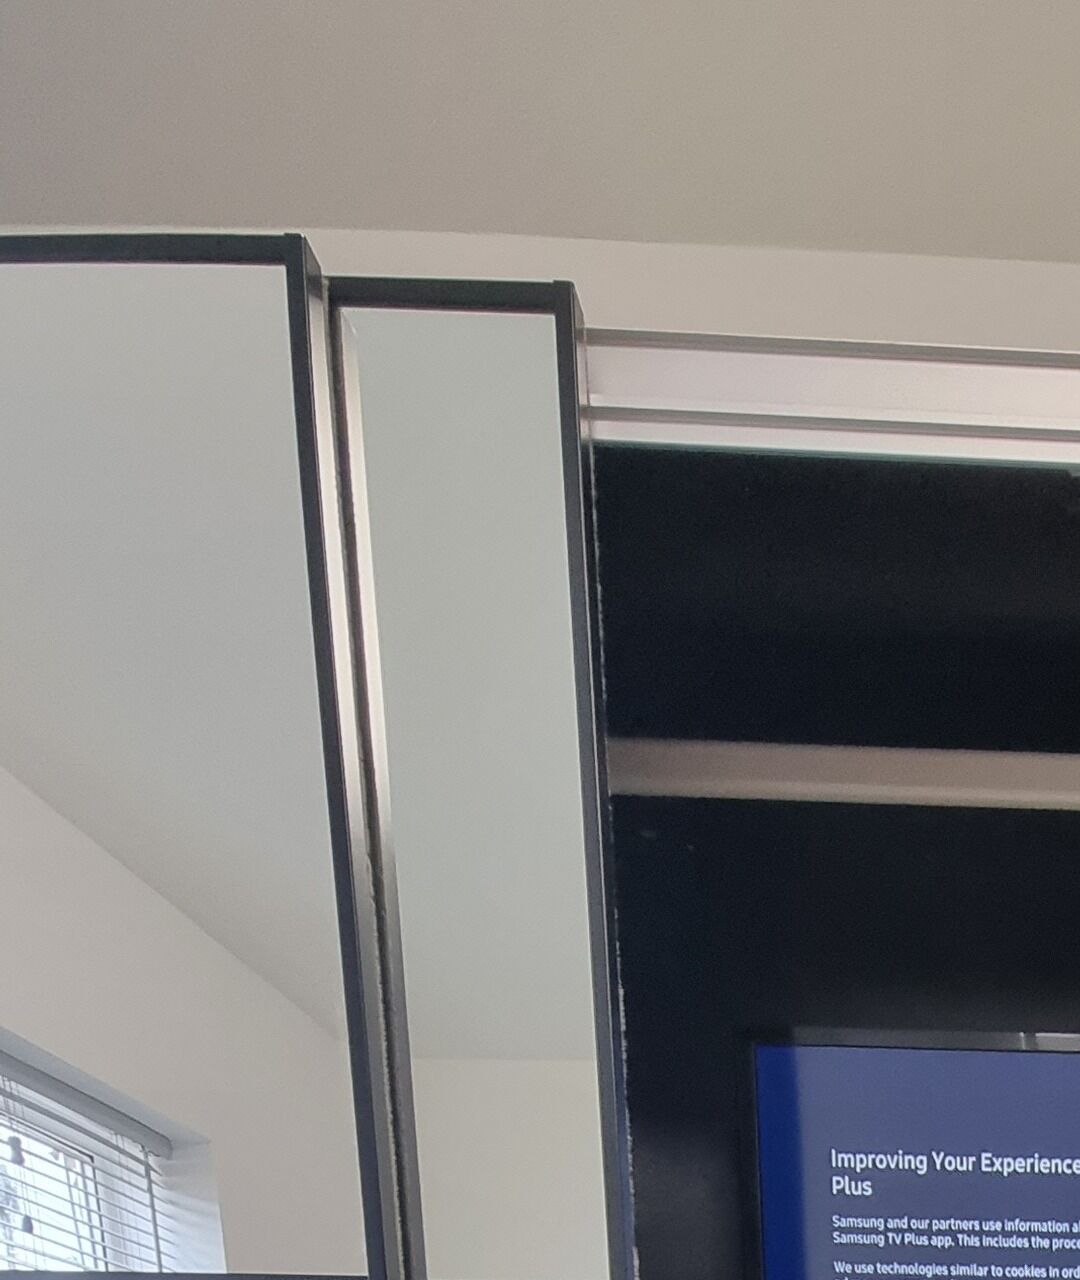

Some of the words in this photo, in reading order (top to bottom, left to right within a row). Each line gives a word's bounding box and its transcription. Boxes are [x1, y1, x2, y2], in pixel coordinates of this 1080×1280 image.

[829, 1148, 927, 1175] Improving
[932, 1150, 976, 1171] Your
[830, 1174, 872, 1195] Plus
[831, 1214, 884, 1233] Samsung
[886, 1215, 907, 1230] and
[909, 1218, 929, 1230] our
[932, 1217, 979, 1235] partners
[981, 1220, 1002, 1232] use
[1004, 1217, 1069, 1233] information
[832, 1230, 884, 1249] Samsung
[887, 1231, 901, 1245] TV
[903, 1231, 928, 1246] Plus
[930, 1235, 954, 1250] app.
[956, 1233, 980, 1247] This
[982, 1233, 1029, 1248] includes
[1030, 1234, 1050, 1248] the
[833, 1260, 852, 1274] We
[853, 1263, 874, 1275] use
[875, 1261, 948, 1280] technologies
[949, 1262, 988, 1277] similar
[990, 1264, 1003, 1277] to
[1004, 1263, 1046, 1278] cookies
[1048, 1264, 1059, 1278] in
